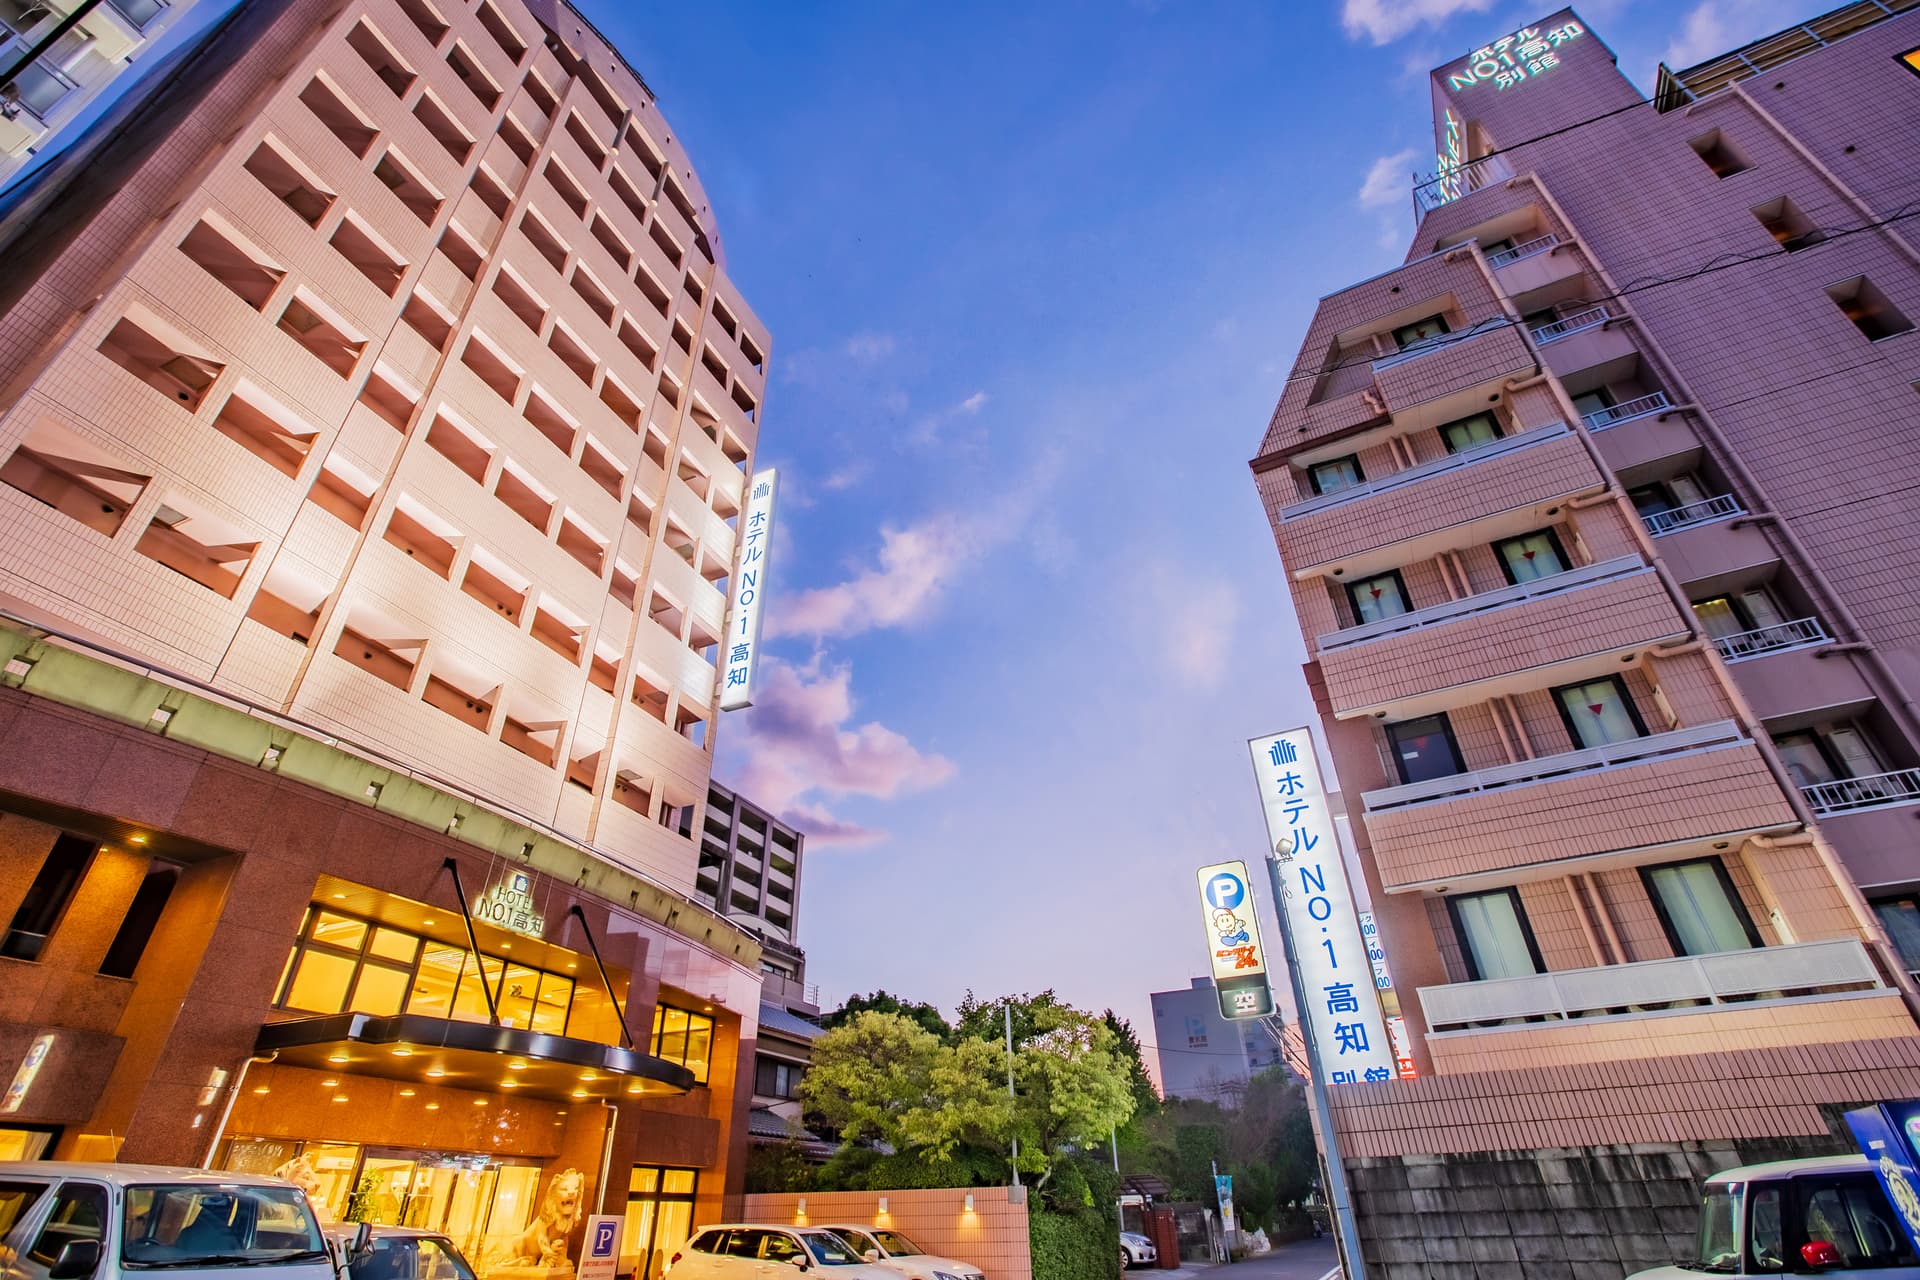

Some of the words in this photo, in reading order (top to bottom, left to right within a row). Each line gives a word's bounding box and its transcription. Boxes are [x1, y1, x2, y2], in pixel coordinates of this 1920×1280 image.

[1470, 27, 1541, 64] ホテル
[1493, 51, 1561, 91] 別館
[496, 887, 531, 909] HOTE
[1213, 878, 1239, 908] P
[597, 1229, 612, 1249] P
